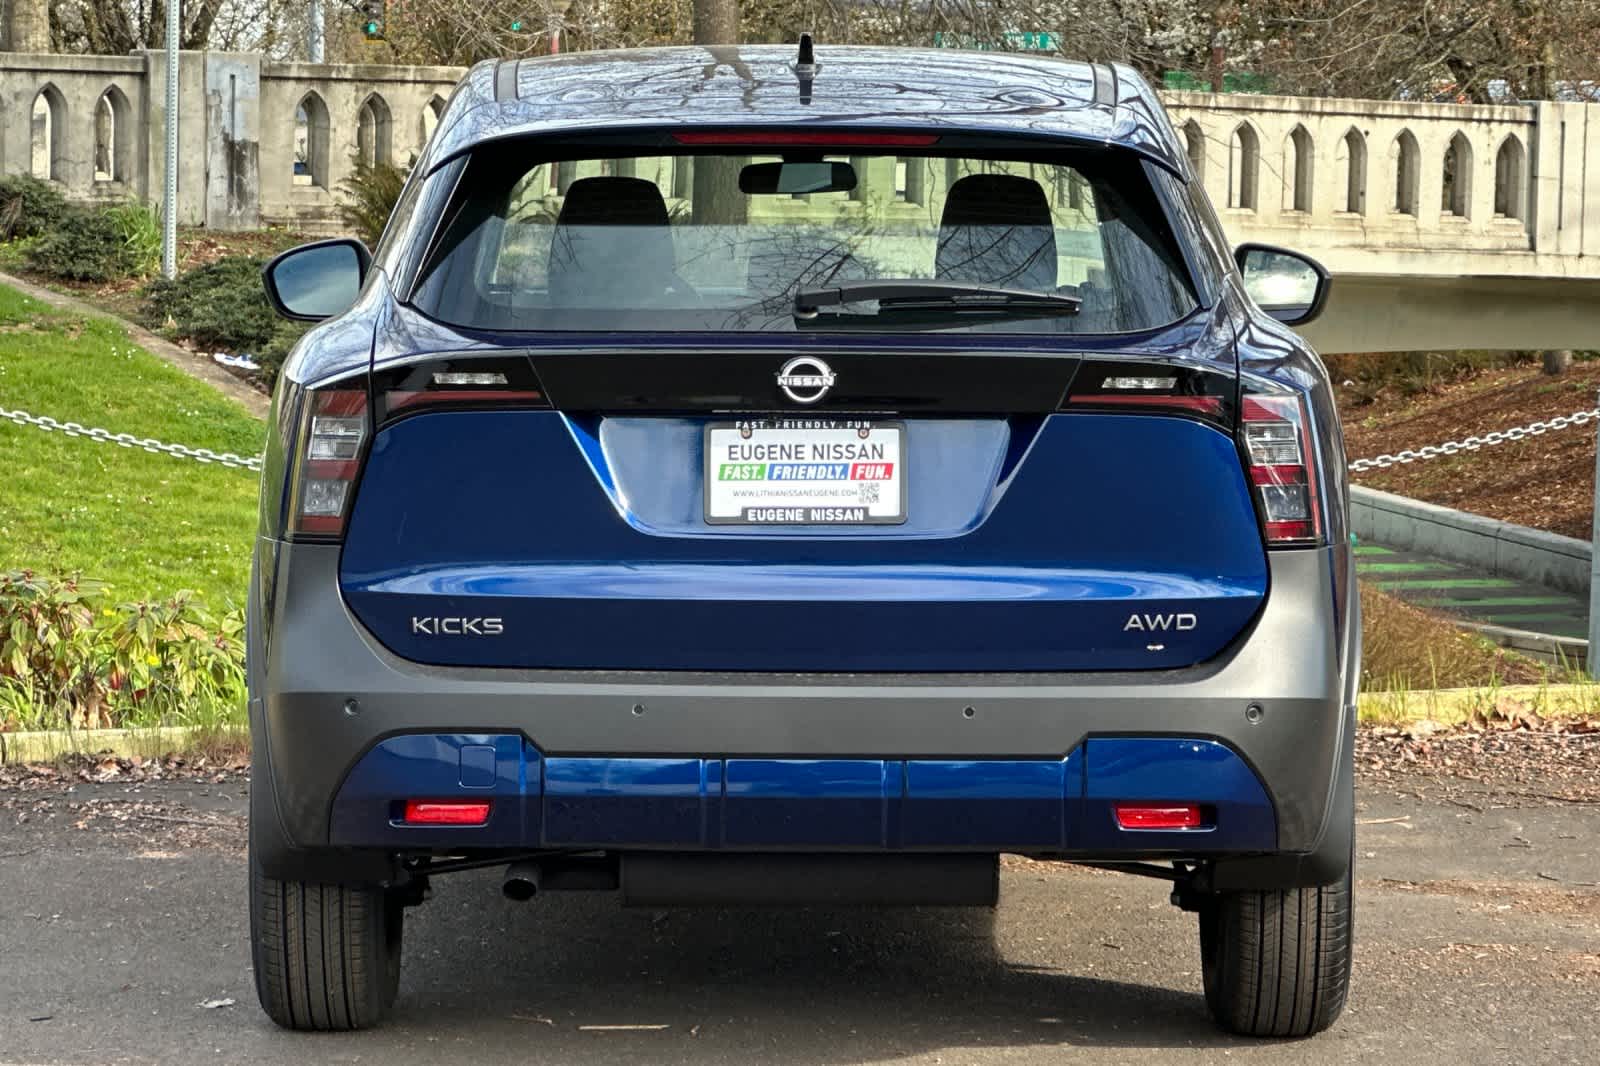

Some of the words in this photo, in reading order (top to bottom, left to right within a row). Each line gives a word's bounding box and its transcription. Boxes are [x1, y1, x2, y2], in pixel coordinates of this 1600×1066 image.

[777, 376, 834, 386] NISSAN
[728, 444, 806, 461] EUGENE
[812, 444, 884, 461] NISSAN
[723, 465, 762, 480] FAST.
[772, 465, 846, 480] FRIENDLY.
[855, 465, 890, 480] FUN.
[747, 509, 804, 521] EUGENE
[811, 509, 864, 521] NISSAN
[412, 616, 504, 635] KICKS
[1123, 613, 1197, 631] AWD
